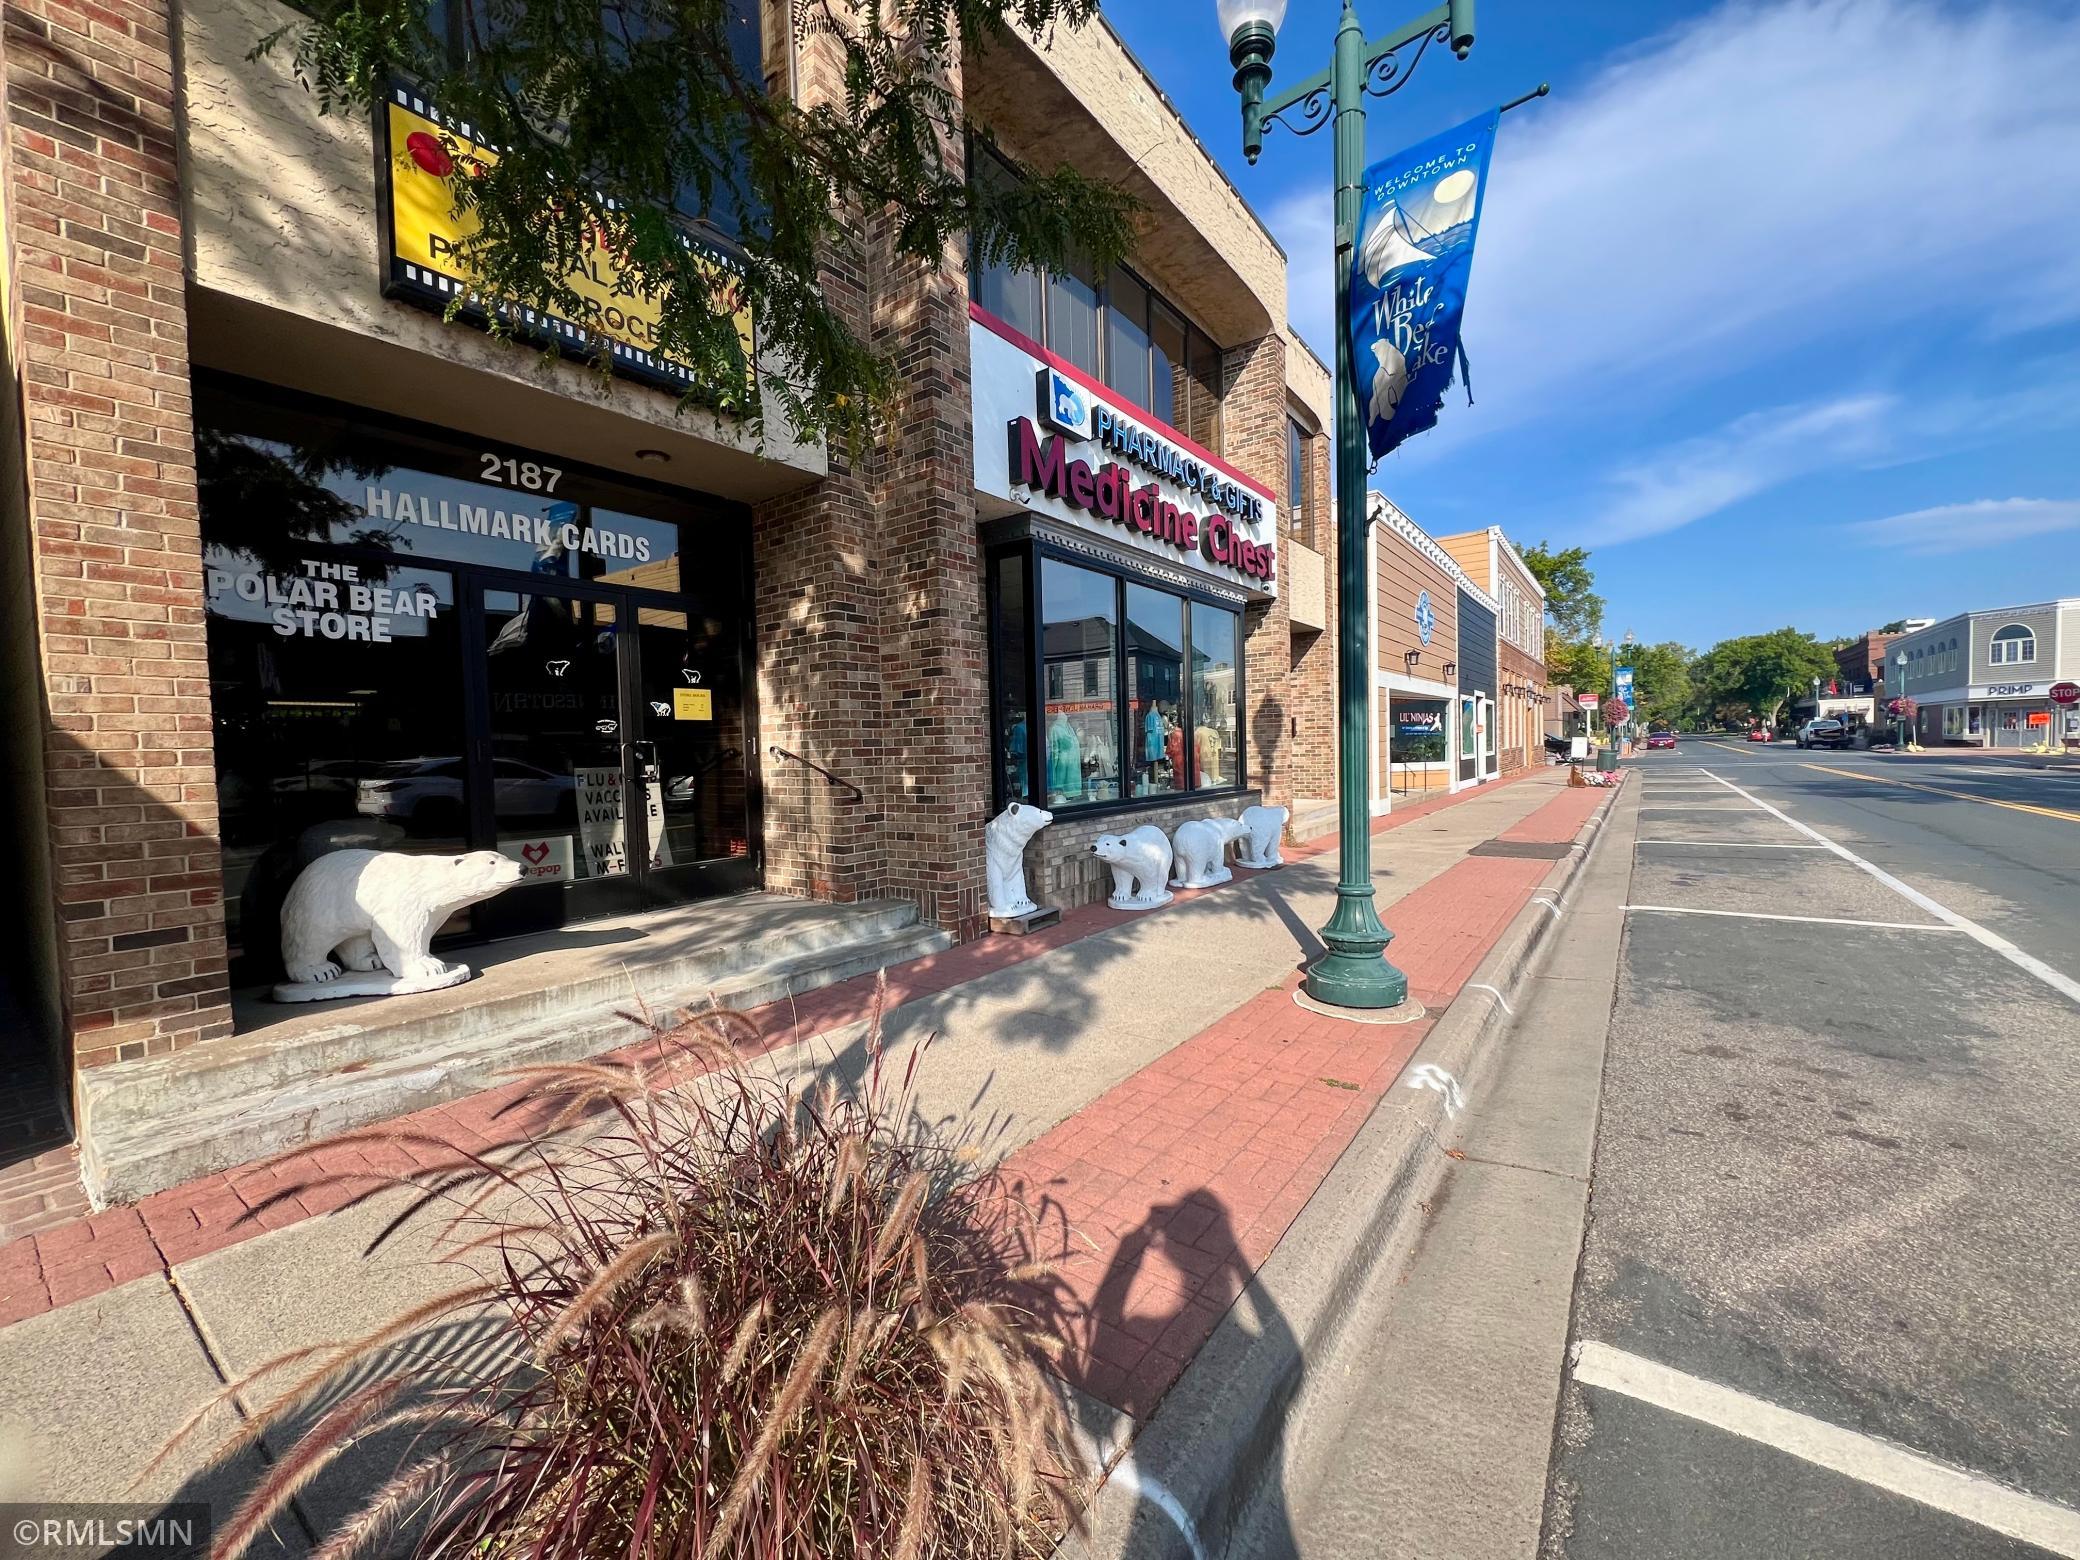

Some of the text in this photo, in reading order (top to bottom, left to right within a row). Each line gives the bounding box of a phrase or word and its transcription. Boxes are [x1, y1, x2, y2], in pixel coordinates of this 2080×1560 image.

[1375, 143, 1476, 196] WELCOME TO
[1377, 155, 1467, 201] DOWNTOWN
[1372, 276, 1435, 337] White
[480, 453, 562, 493] 2187
[1094, 405, 1263, 522] PHARMACY & GIFTS
[1010, 416, 1276, 581] Medicine Chest
[366, 486, 650, 562] HALLMARK CARDS
[207, 568, 438, 619] POLAR BEAR
[301, 559, 360, 582] THE
[272, 607, 392, 643] STORE
[1987, 684, 2033, 696] PRIMP
[2051, 688, 2080, 698] STOP
[577, 773, 616, 787] FLU &
